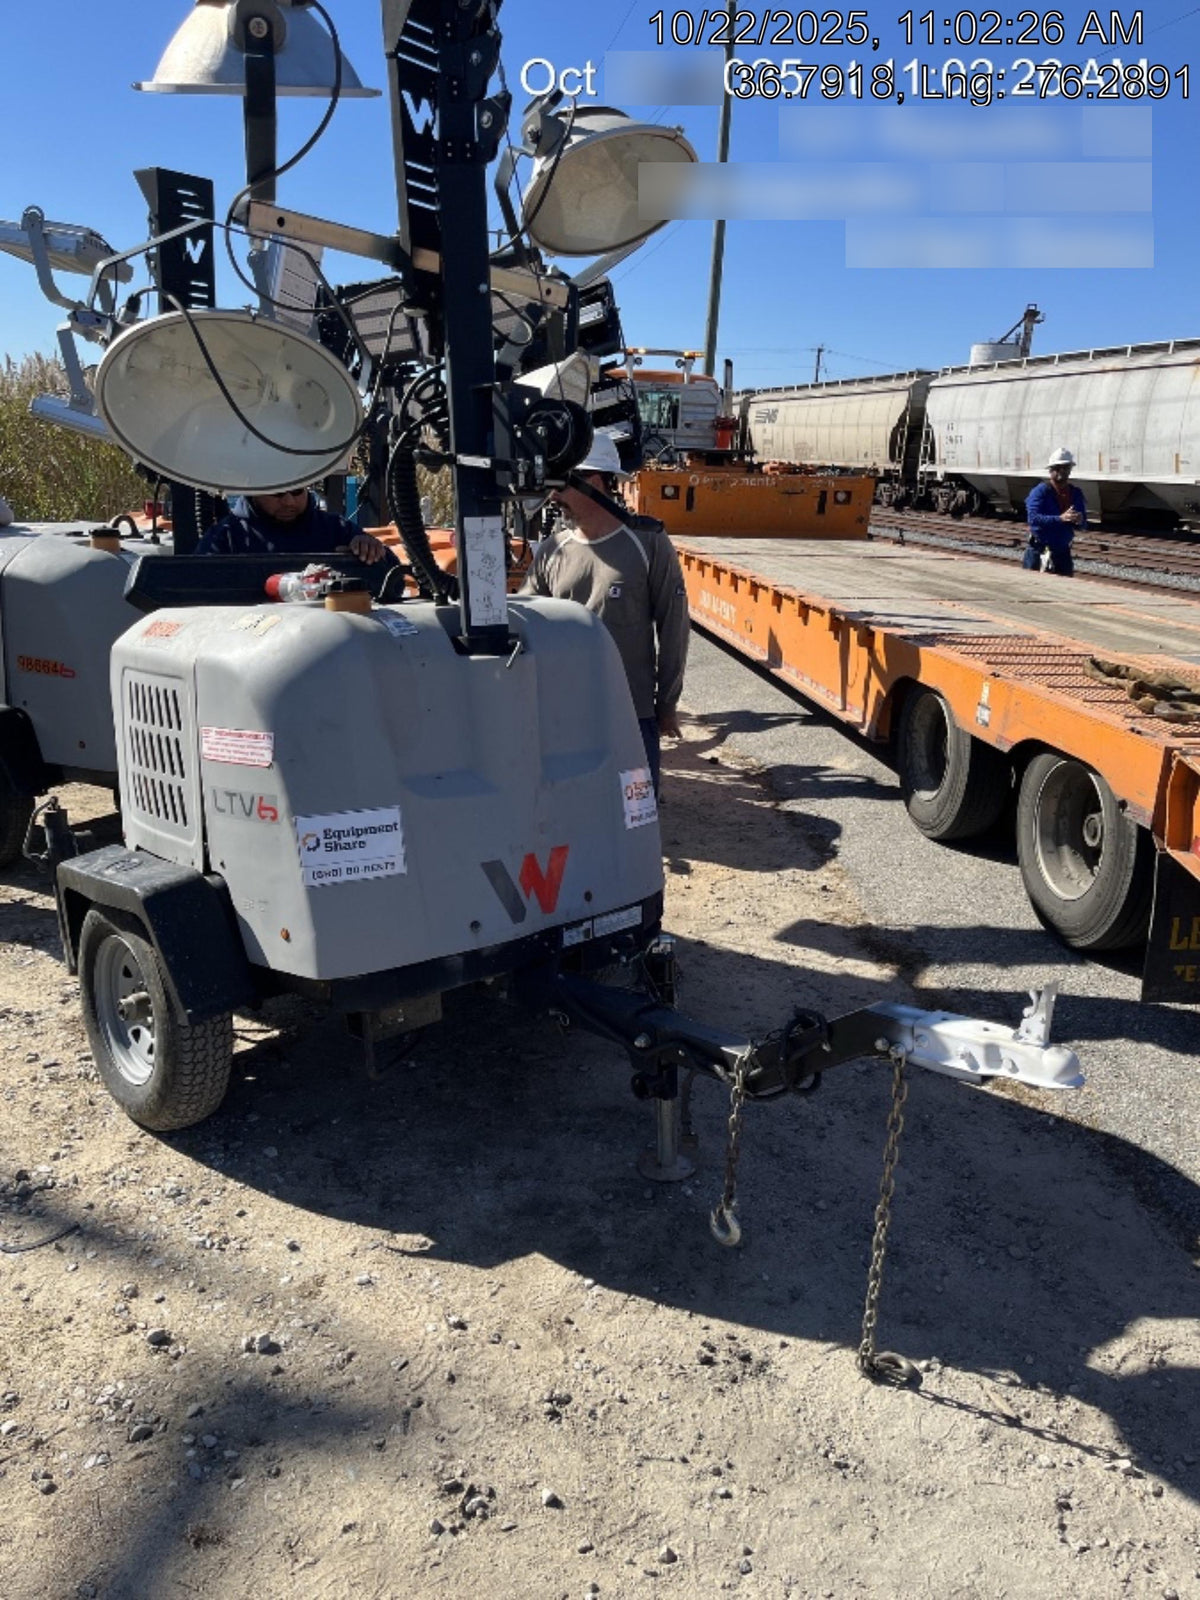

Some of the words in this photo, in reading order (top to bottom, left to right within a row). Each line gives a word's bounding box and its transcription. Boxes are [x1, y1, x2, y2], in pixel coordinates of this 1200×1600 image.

[212, 789, 279, 822] LTV6
[323, 822, 399, 840] Equipment
[324, 841, 366, 852] Share
